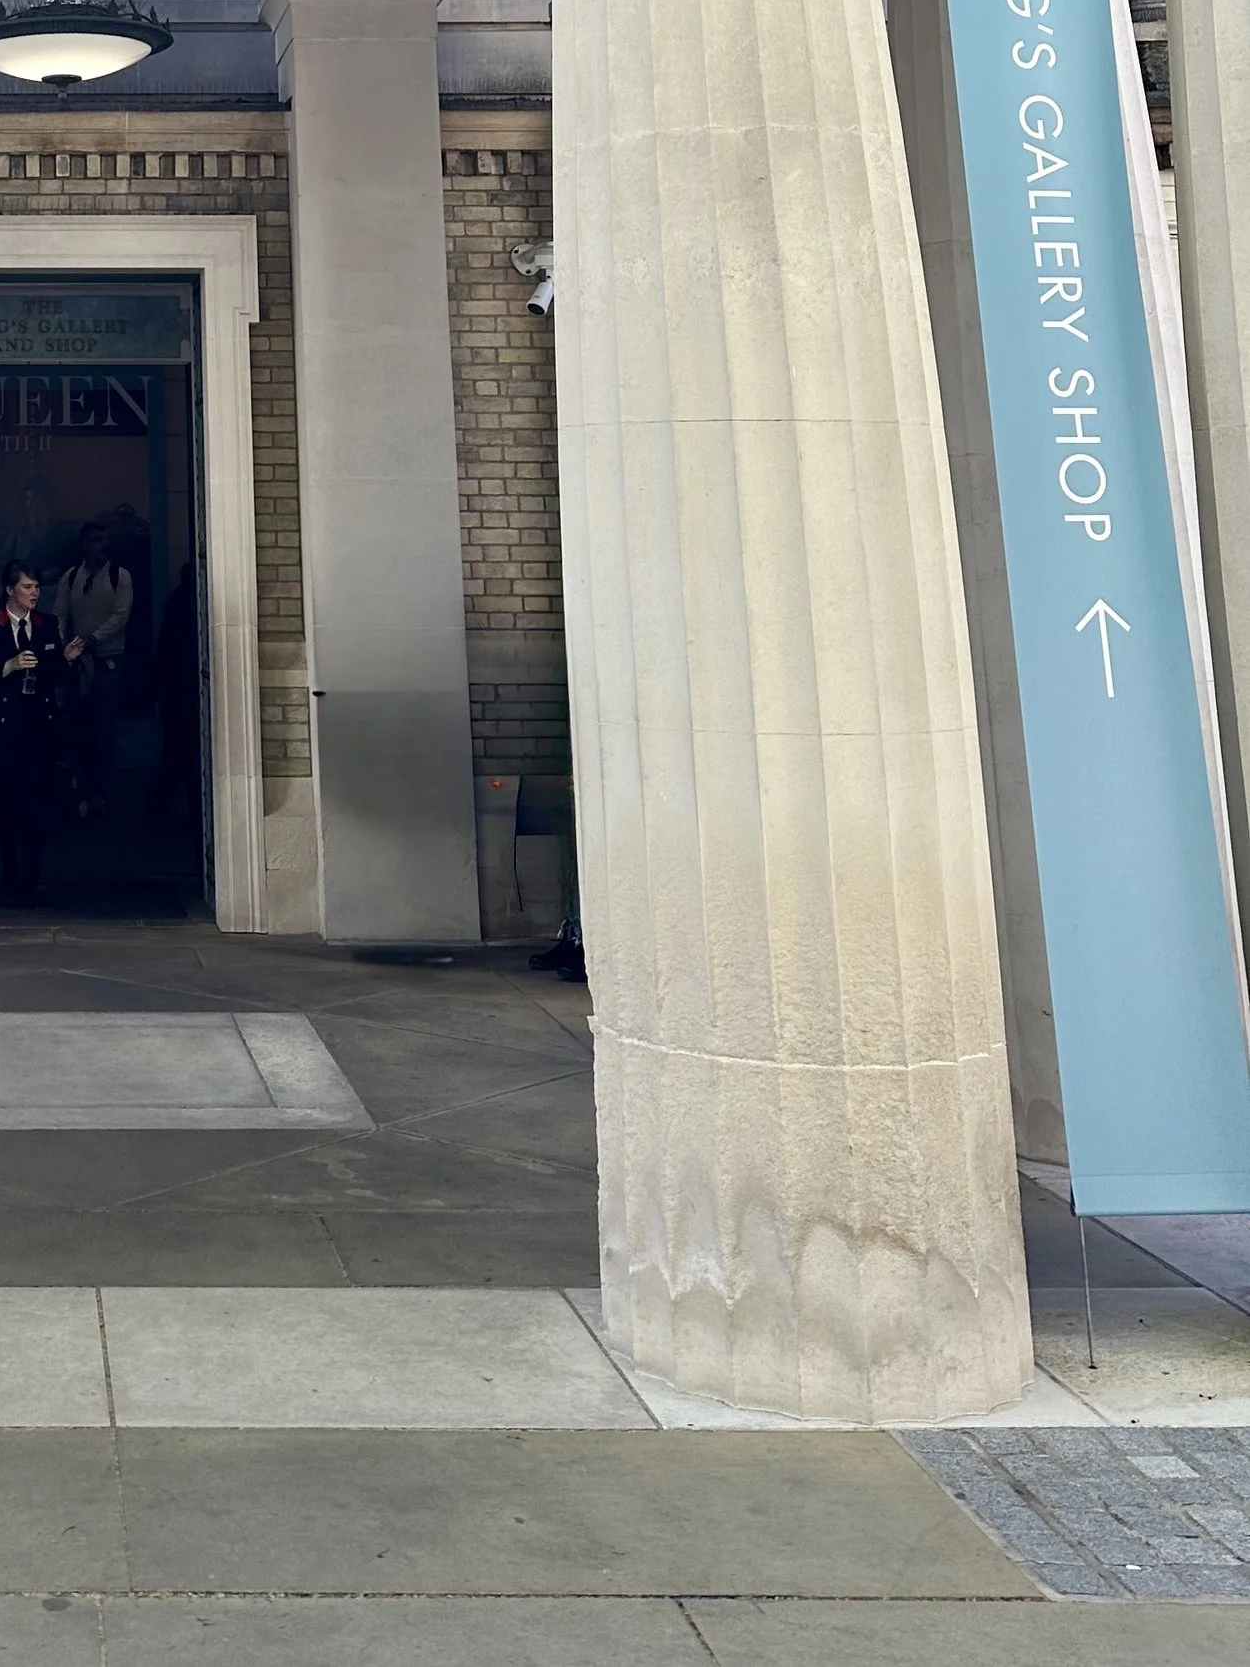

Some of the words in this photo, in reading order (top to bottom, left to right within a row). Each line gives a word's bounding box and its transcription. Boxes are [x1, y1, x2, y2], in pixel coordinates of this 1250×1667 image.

[1017, 94, 1090, 343] GALLERY
[23, 300, 64, 315] THE
[38, 319, 129, 334] GALLERY
[45, 338, 98, 353] SHOP
[39, 435, 52, 452] II
[1048, 367, 1113, 543] SHOP
